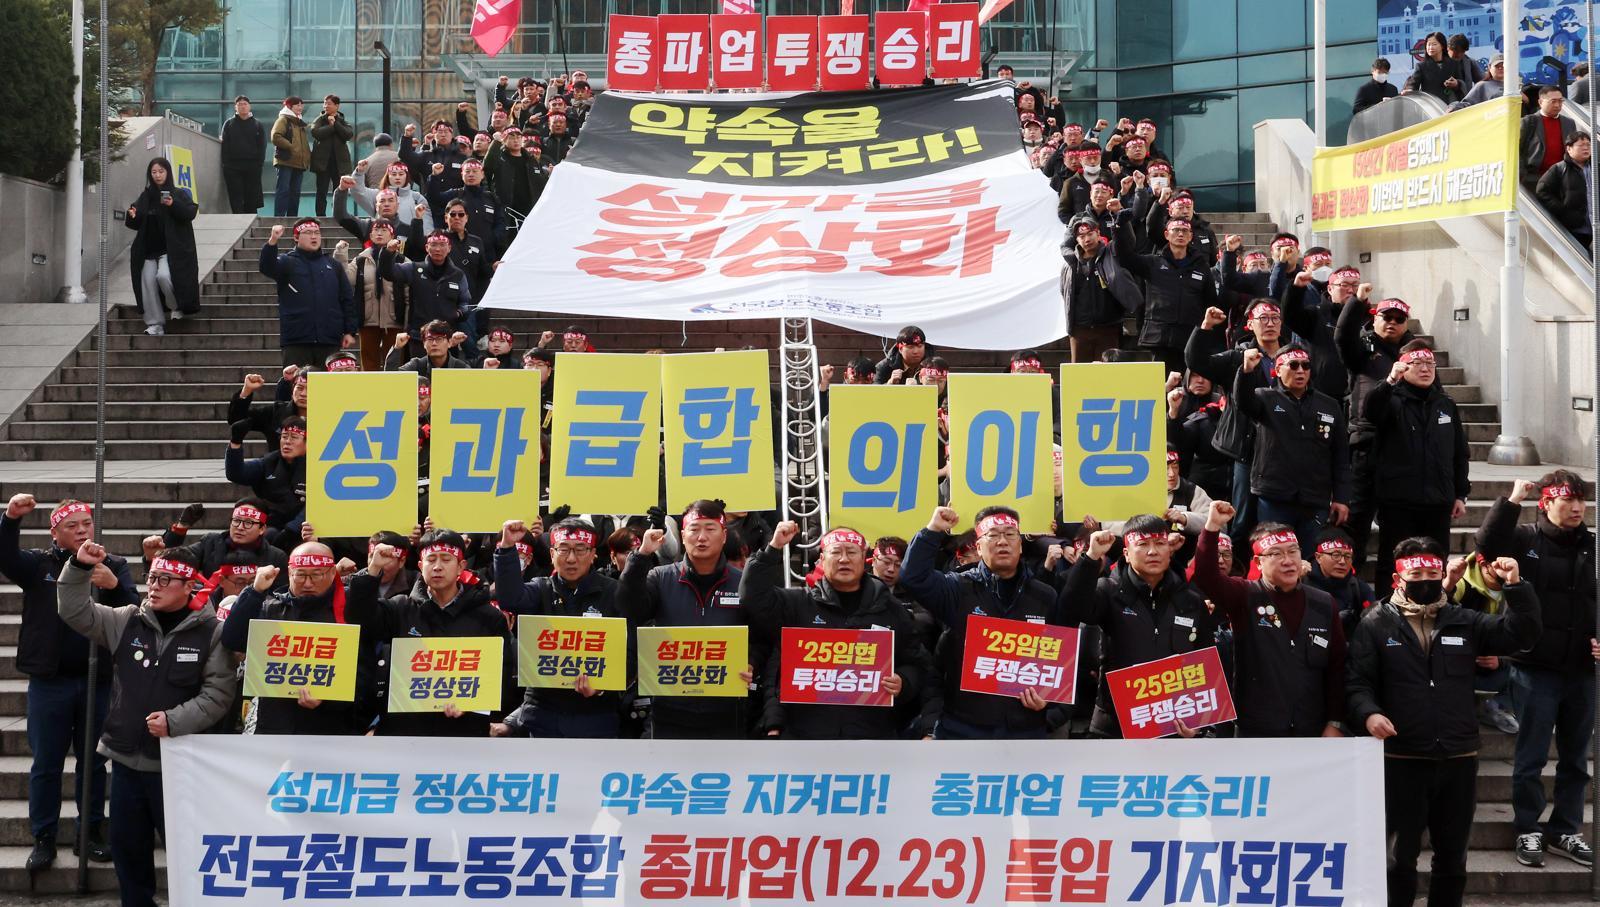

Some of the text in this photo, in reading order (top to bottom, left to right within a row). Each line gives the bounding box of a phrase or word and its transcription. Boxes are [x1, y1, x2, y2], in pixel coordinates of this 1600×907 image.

[629, 102, 882, 147] 약속을
[687, 126, 983, 178] 지켜라!
[1371, 179, 1404, 214] 이번엔
[1407, 172, 1443, 208] 반드시
[1447, 161, 1504, 204] 해결하자
[573, 205, 1011, 282] 정상화
[266, 634, 338, 660] 성과급
[536, 629, 606, 652] 성과급
[656, 640, 727, 661] 성과급
[797, 640, 878, 665] '25임협
[981, 629, 1062, 661] '25임협
[264, 662, 336, 688] 정상화
[410, 649, 481, 672] 성과급
[536, 655, 606, 678] 정상화
[656, 665, 727, 685] 정상화
[973, 656, 1063, 689] 투쟁승리
[408, 676, 480, 699] 정상화
[791, 667, 882, 693] 투쟁승리
[1126, 663, 1207, 700] '25임협
[1130, 689, 1218, 729] 투쟁승리
[267, 771, 1270, 819] 성과급 정상화! 약속을 지켜라! 총파업 투쟁승리!
[198, 833, 1348, 907] 전국철도노동조합 총파업(12.23) 돌입 기자회견
